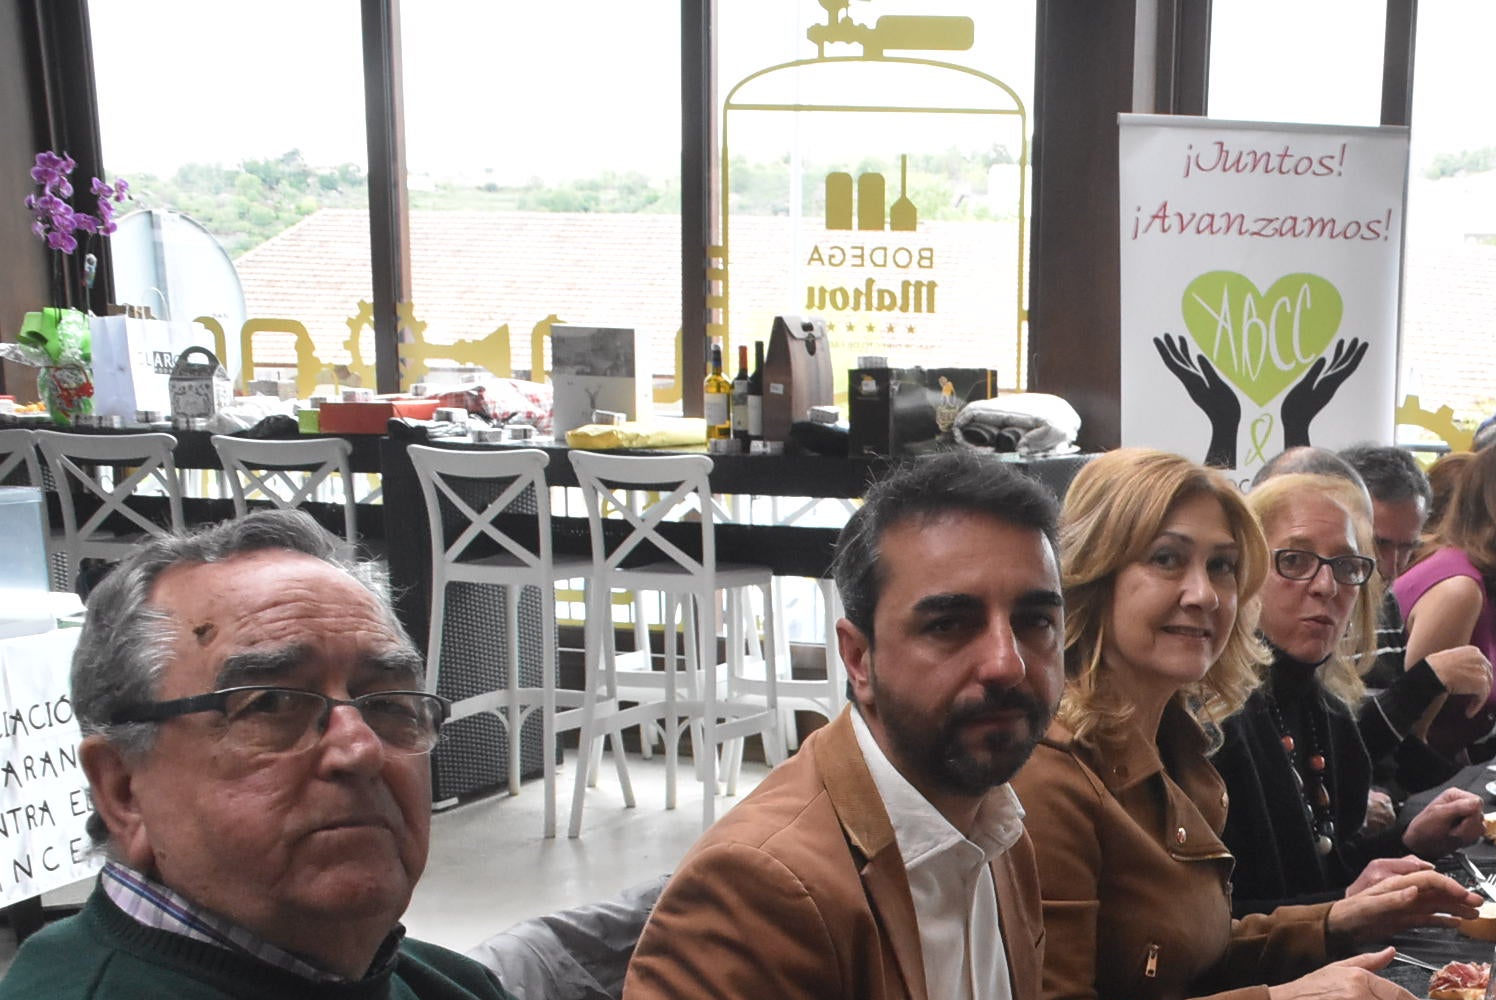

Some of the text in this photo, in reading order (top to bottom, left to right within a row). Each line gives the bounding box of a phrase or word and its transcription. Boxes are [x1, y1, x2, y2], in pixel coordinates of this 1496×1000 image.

[1182, 141, 1347, 178] ¡Juntos!
[1131, 200, 1392, 242] ¡Avanzamos!
[0, 694, 74, 738] IACIÓ
[0, 837, 85, 893] NCE
